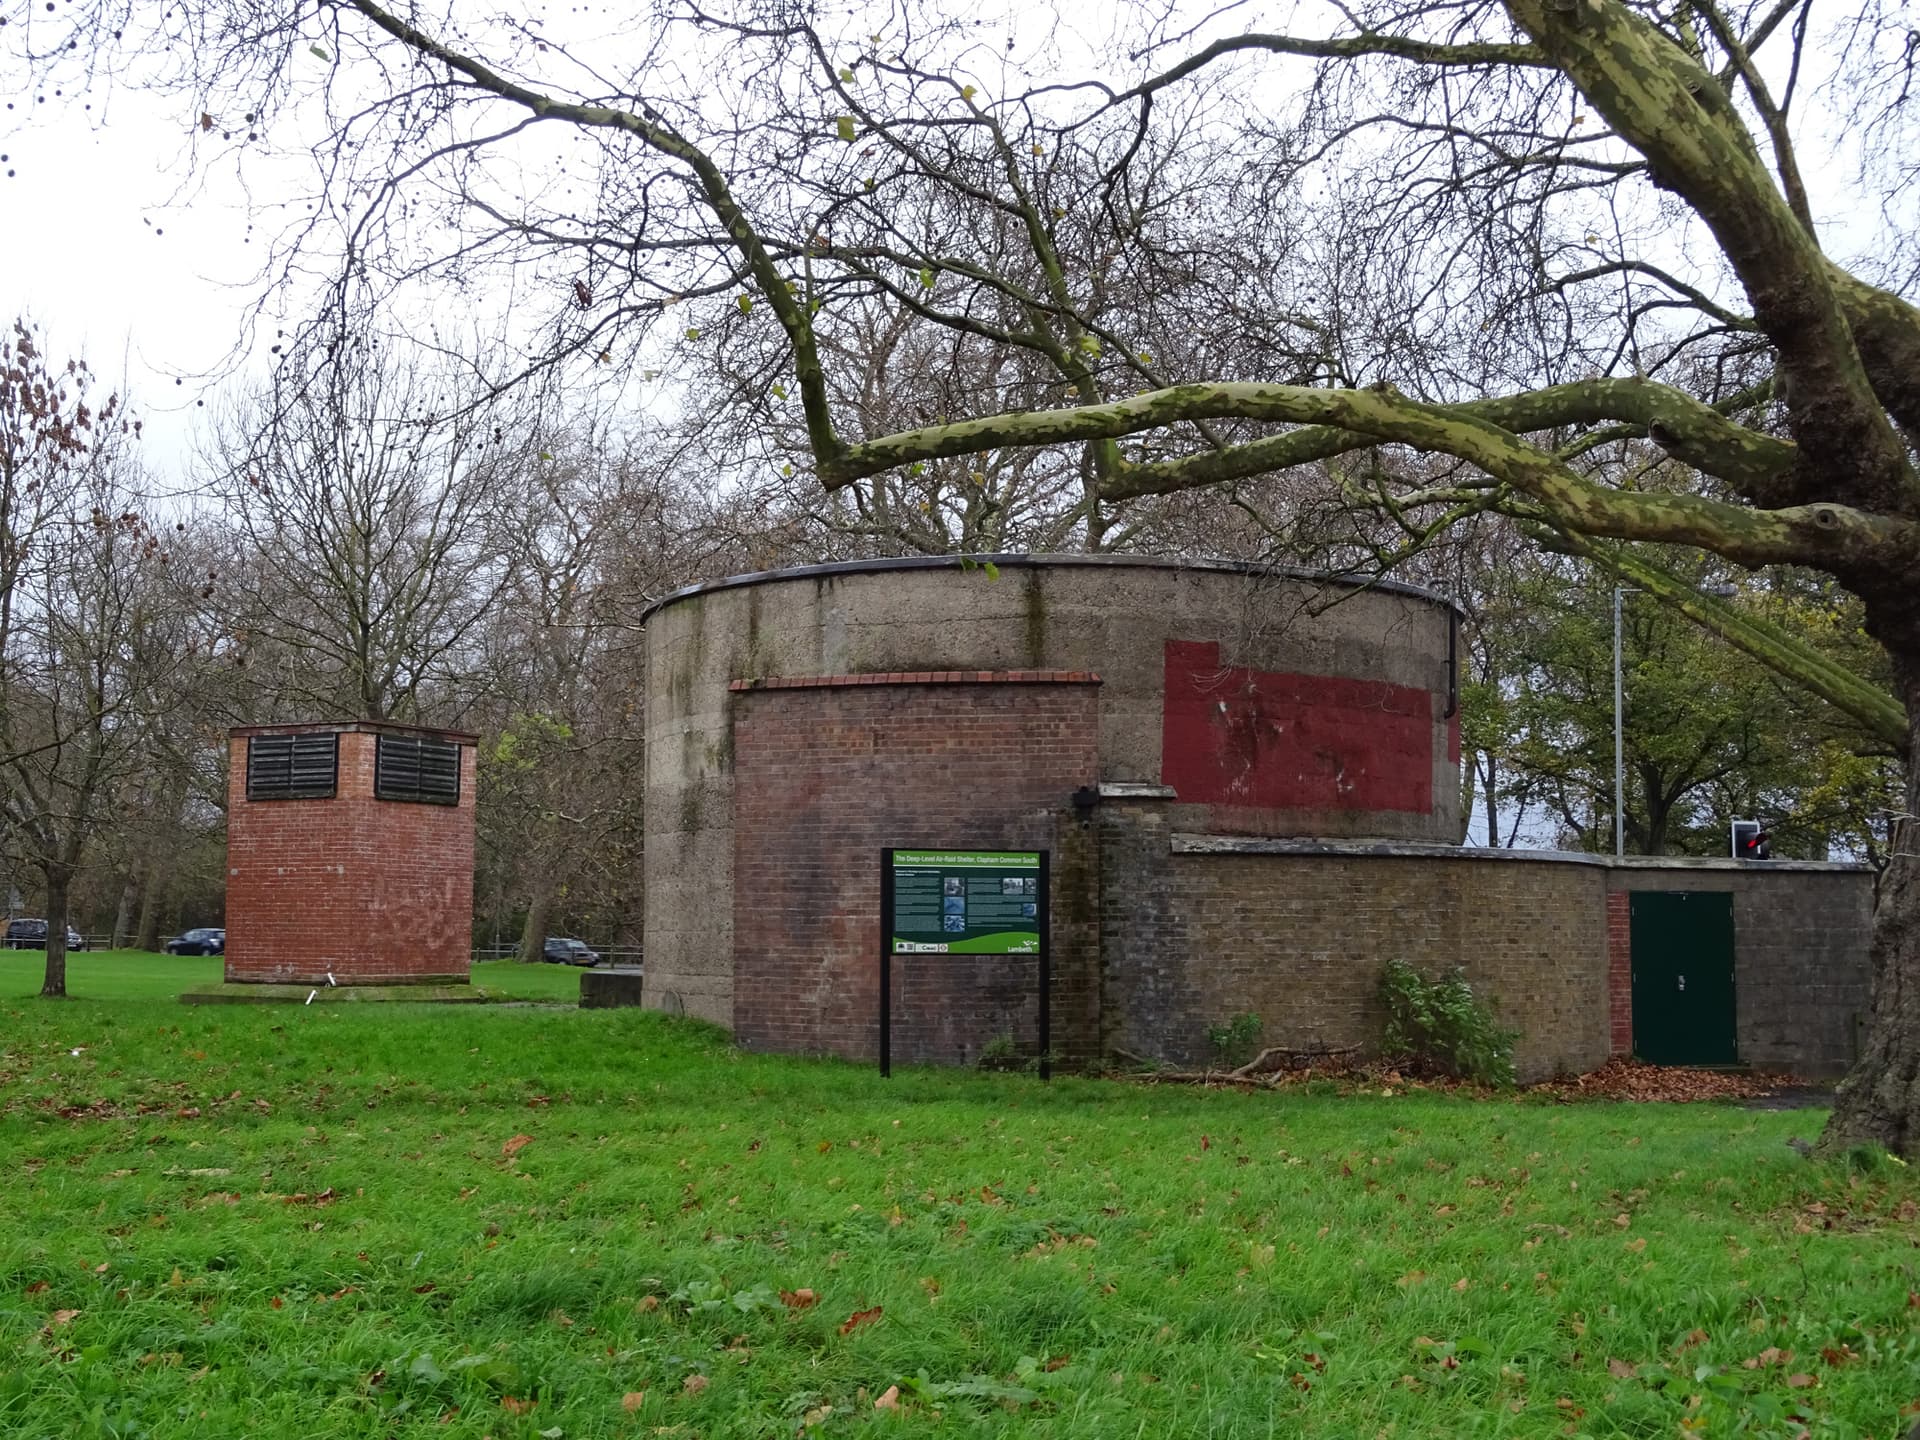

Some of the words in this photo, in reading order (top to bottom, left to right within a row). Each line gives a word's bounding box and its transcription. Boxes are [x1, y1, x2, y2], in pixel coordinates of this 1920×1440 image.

[906, 855, 935, 863] Deep-Level
[936, 855, 956, 863] Air-Raid
[976, 856, 999, 864] Clapham
[999, 856, 1022, 864] Common
[1022, 856, 1038, 864] South
